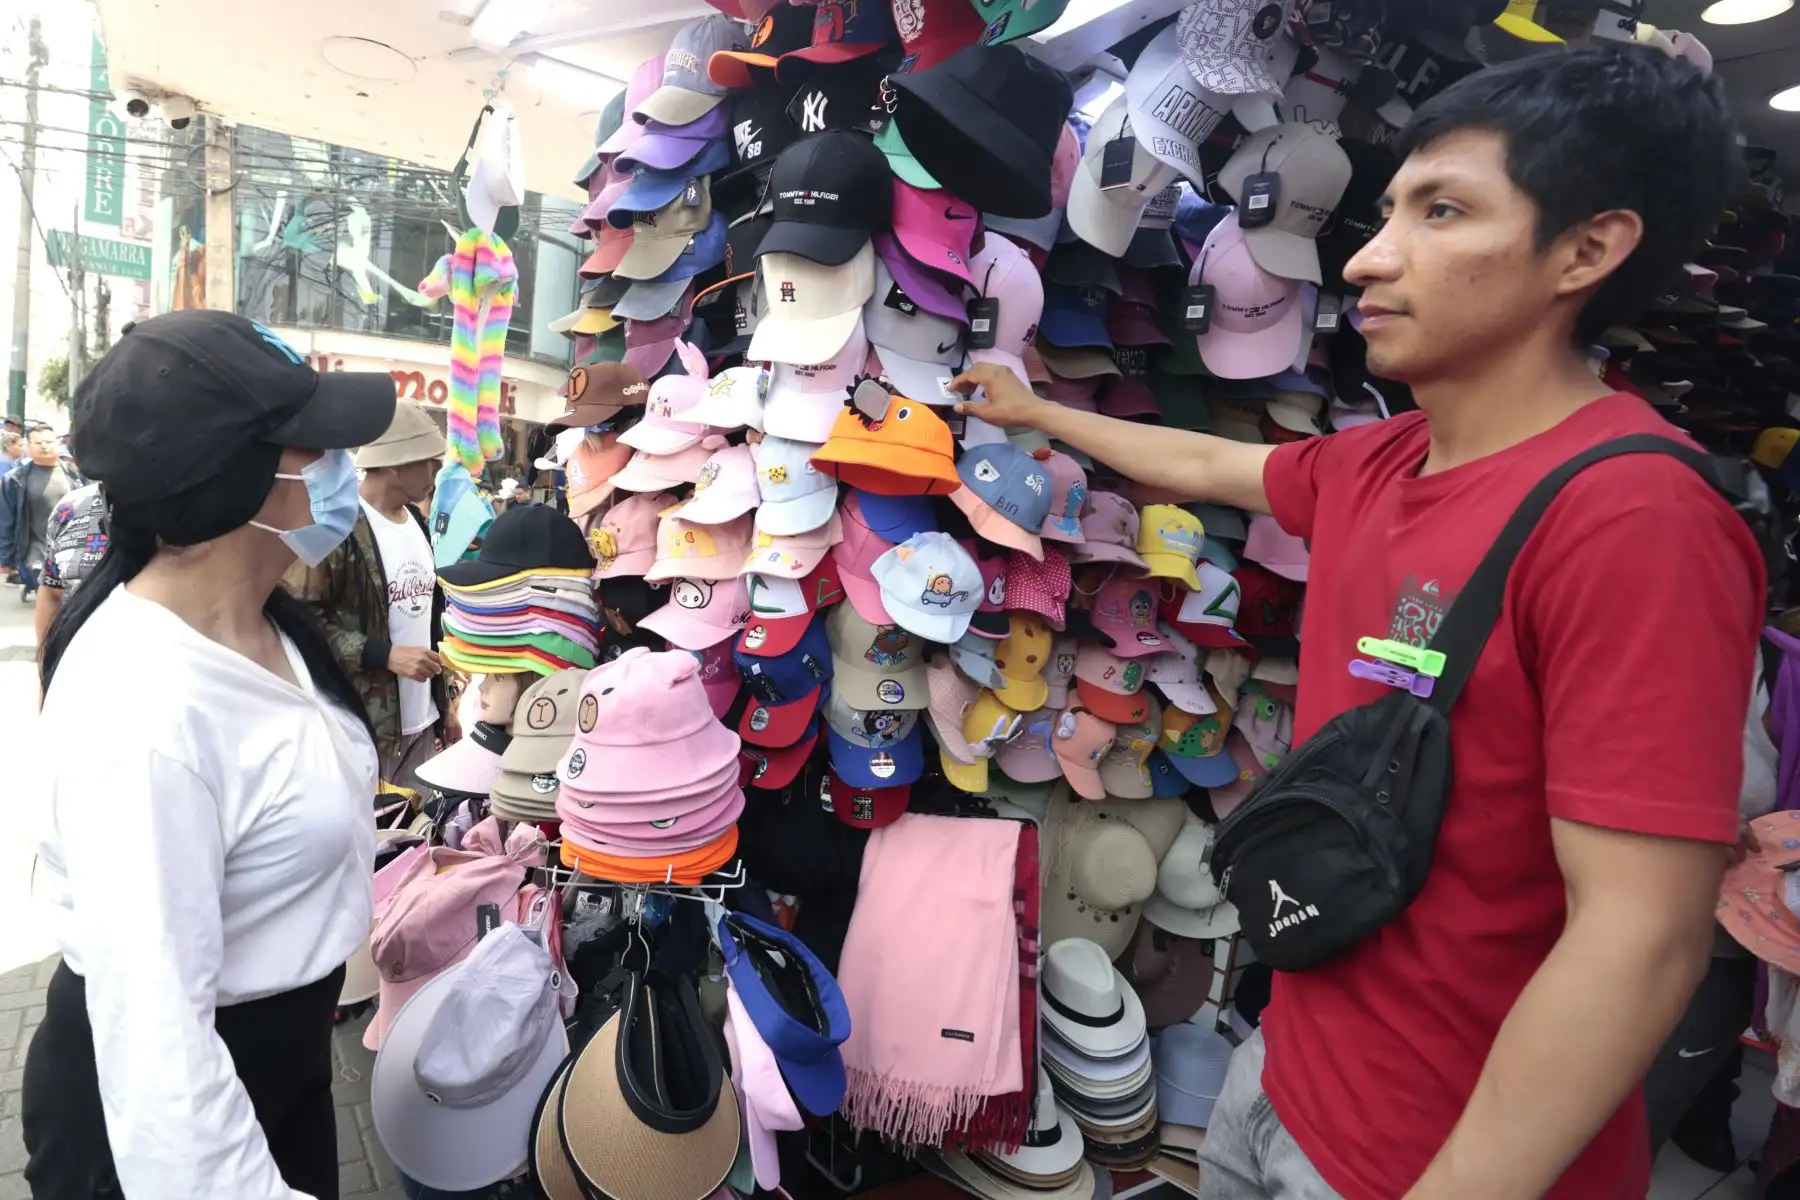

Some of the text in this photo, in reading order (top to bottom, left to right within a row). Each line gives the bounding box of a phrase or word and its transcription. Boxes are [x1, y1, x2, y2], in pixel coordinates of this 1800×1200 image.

[802, 90, 828, 132] NY
[94, 112, 118, 216] ORRE
[747, 140, 763, 159] SB
[779, 190, 839, 200] TOMMY HILFIGER
[79, 234, 146, 265] GAMARRA
